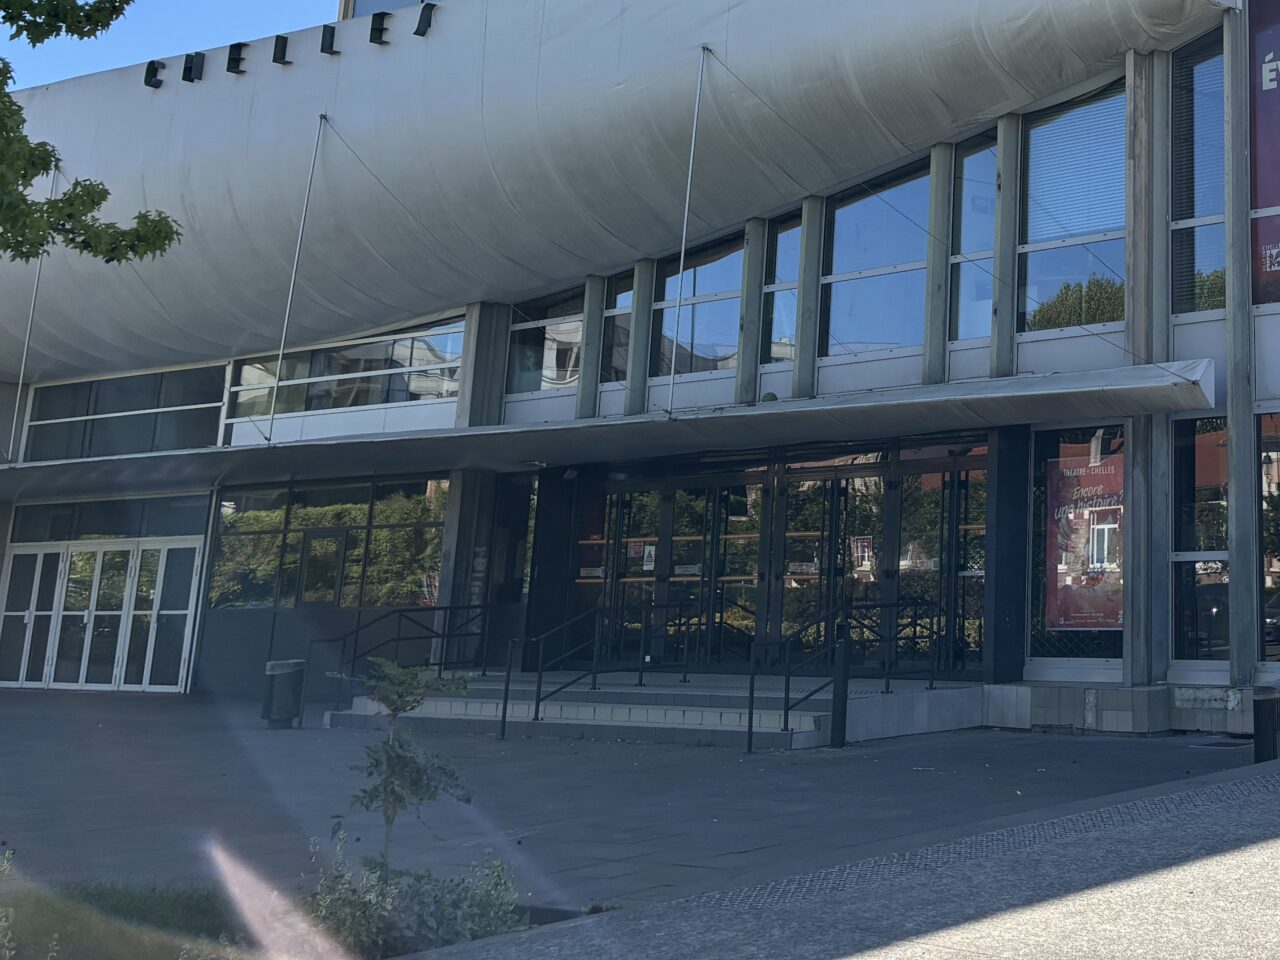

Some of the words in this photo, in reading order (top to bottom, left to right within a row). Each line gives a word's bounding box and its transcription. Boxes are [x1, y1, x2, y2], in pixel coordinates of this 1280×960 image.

[1091, 465, 1115, 475] CHELLES
[1072, 484, 1104, 500] Encore
[1054, 504, 1075, 520] une
